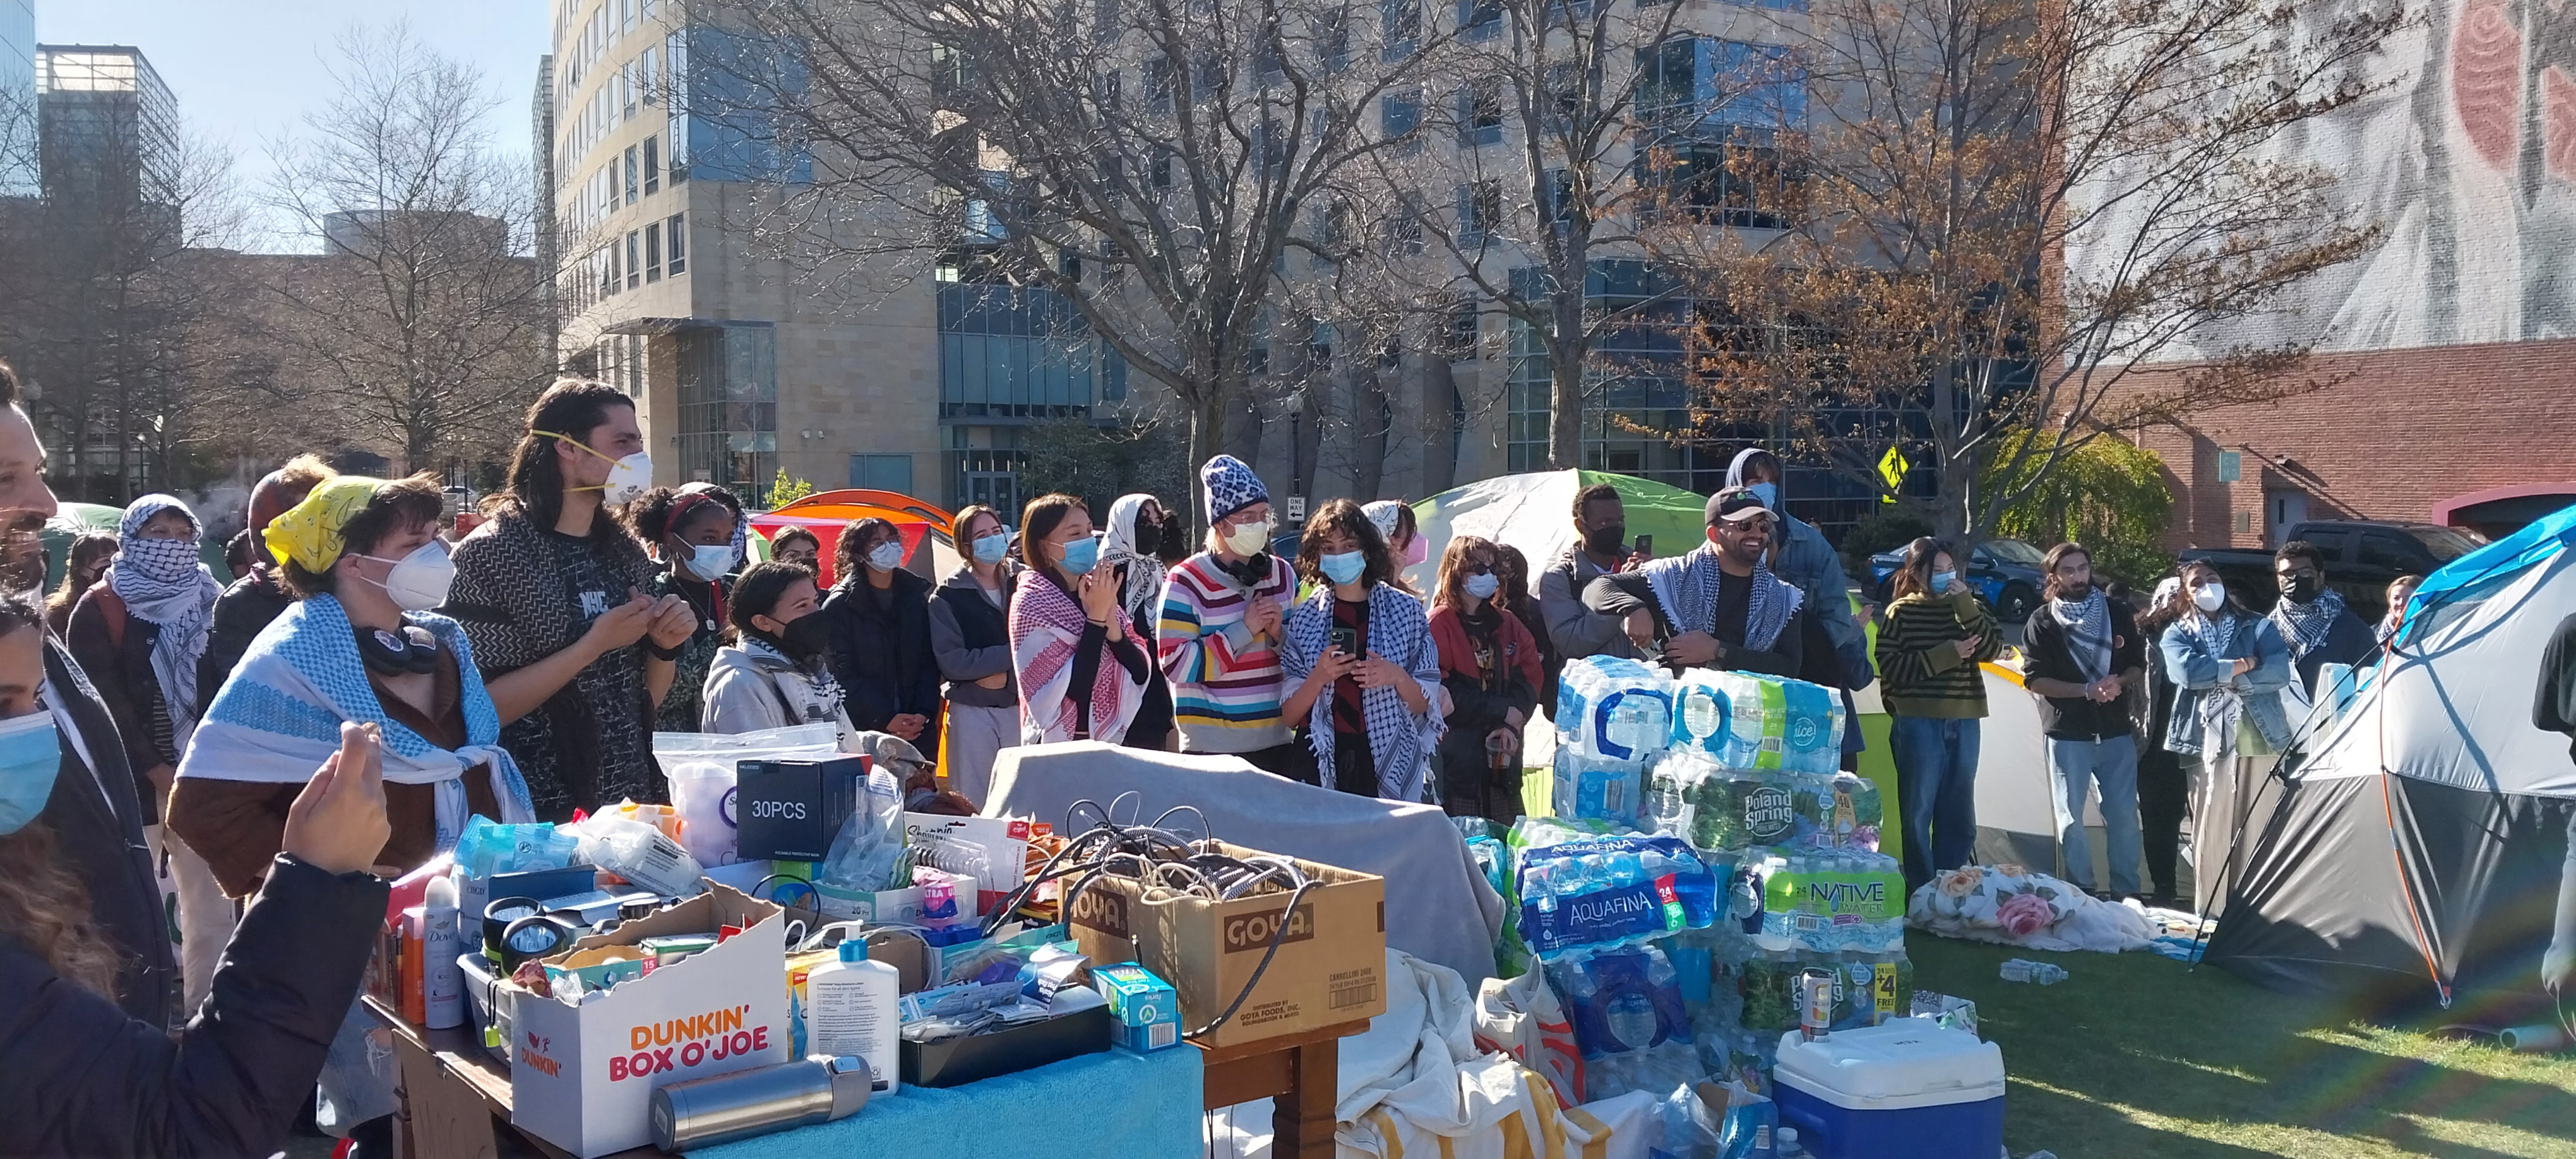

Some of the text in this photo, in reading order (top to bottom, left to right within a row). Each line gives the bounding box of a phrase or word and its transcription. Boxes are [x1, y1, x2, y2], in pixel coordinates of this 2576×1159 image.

[579, 591, 609, 619] NYC
[752, 800, 806, 819] 30PCS
[1745, 790, 1792, 814] Poland
[1839, 795, 1850, 809] 40
[1746, 807, 1792, 830] Spring
[1551, 839, 1635, 852] AQUAFINA
[1659, 886, 1673, 898] 24
[1811, 883, 1885, 902] NATIVE
[852, 906, 861, 915] 20
[1570, 891, 1652, 926] AQUAFINA
[1842, 904, 1884, 913] WATER
[429, 930, 455, 942] Dove
[1227, 911, 1304, 946] GOYA
[644, 960, 655, 969] 15
[1876, 975, 1895, 997] +4
[1253, 1001, 1282, 1010] DISTRIBUTED
[1876, 998, 1895, 1007] FREE
[1240, 1011, 1260, 1021] GOYA
[1261, 1007, 1285, 1017] FOODS,
[631, 1004, 749, 1050] DUNKIN'
[610, 1047, 674, 1081] BOX
